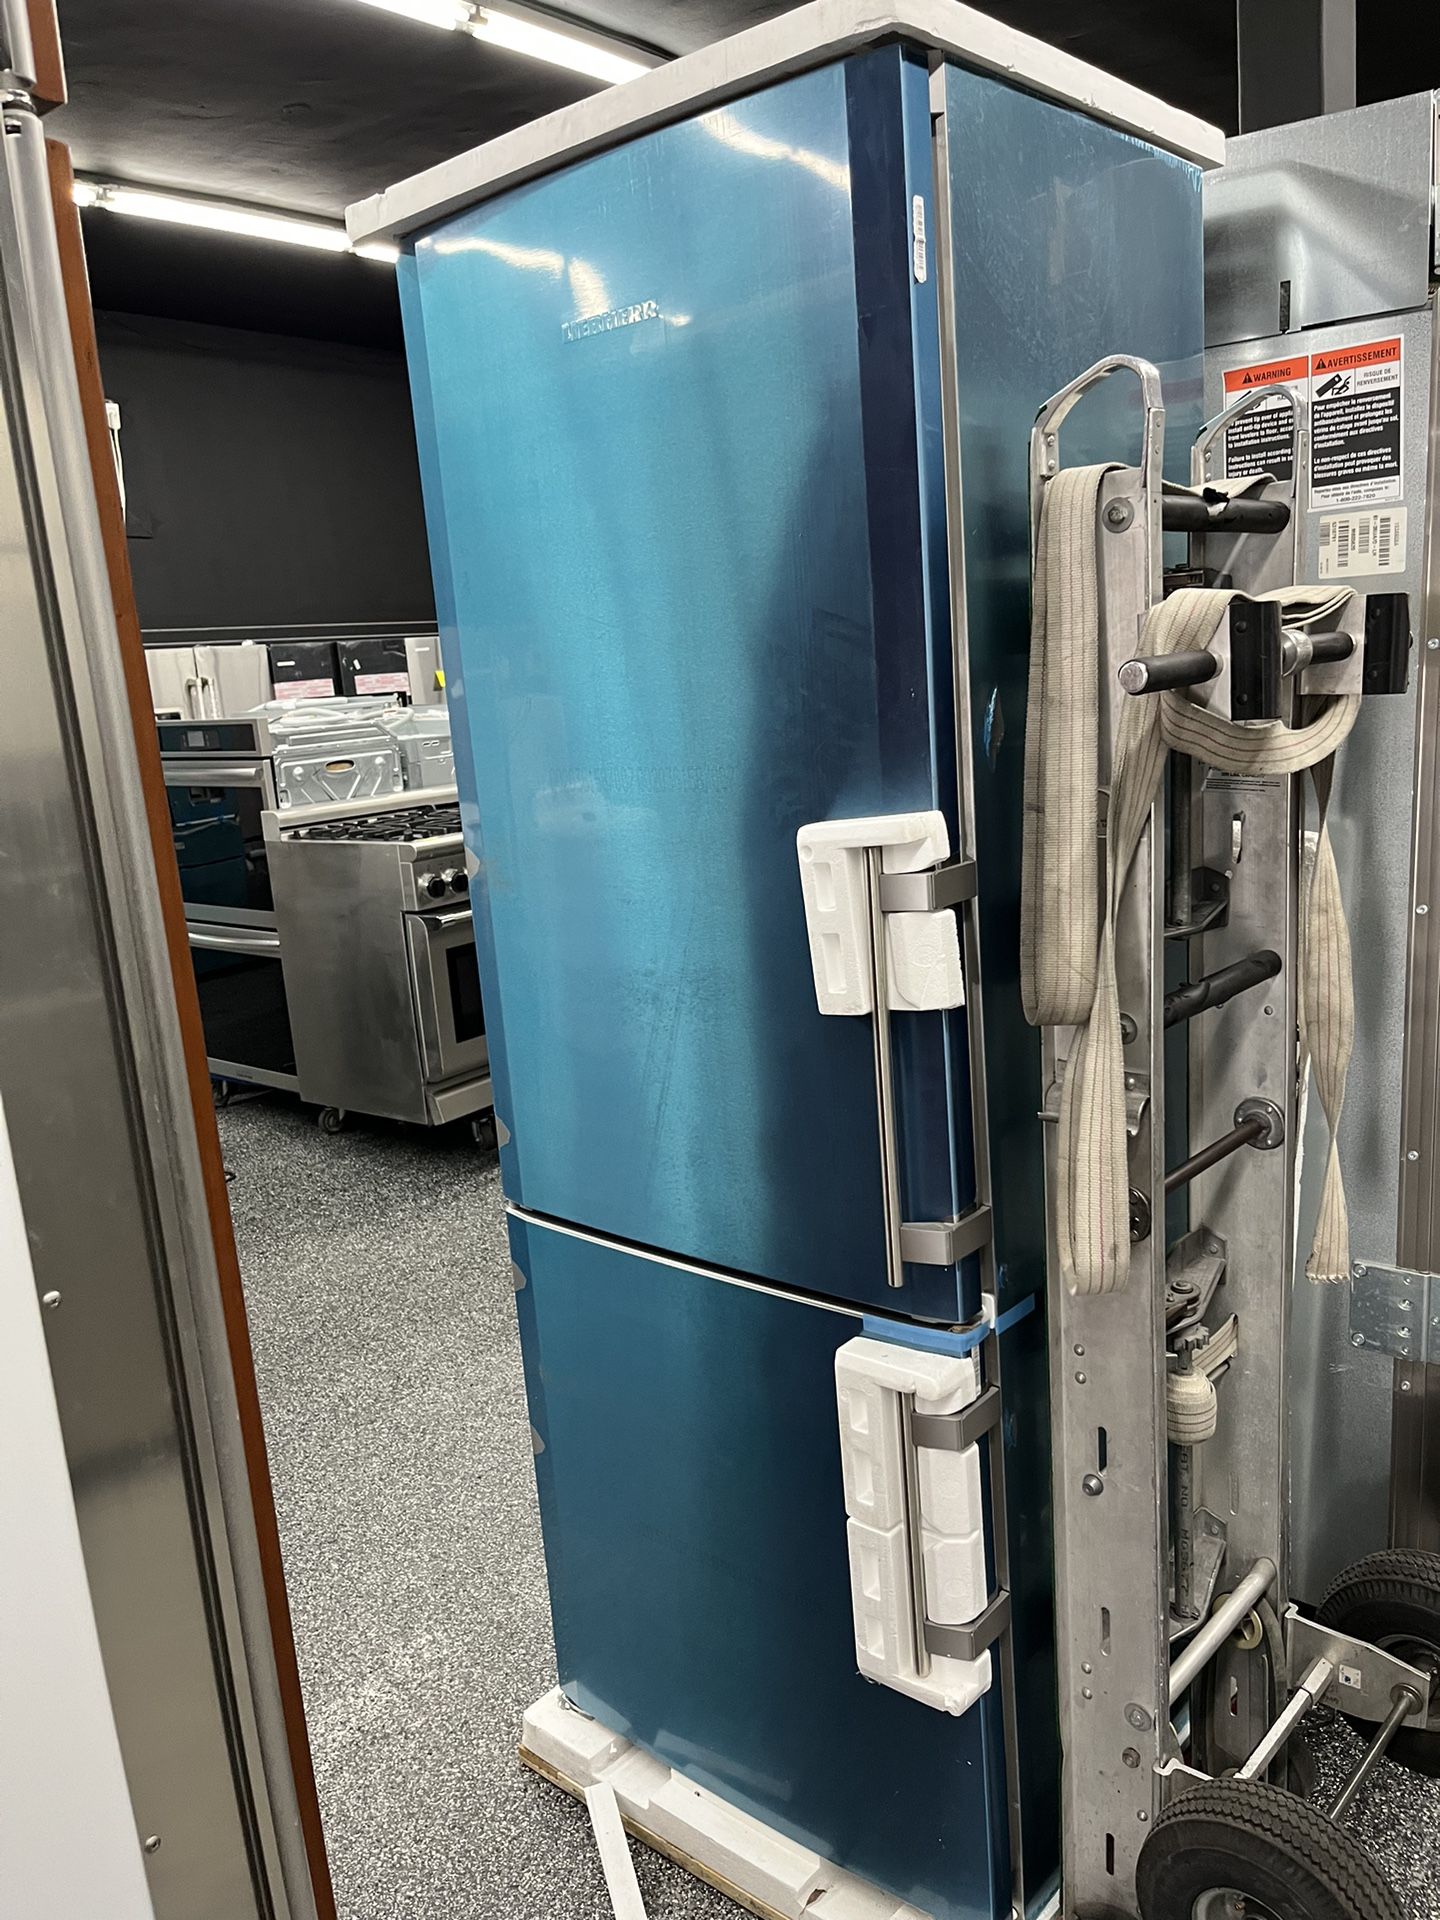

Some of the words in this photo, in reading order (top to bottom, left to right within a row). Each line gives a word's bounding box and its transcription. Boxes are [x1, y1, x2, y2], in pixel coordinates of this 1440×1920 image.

[1327, 347, 1397, 368] AVERTISSEMENT
[1253, 367, 1291, 381] WARNING
[1357, 374, 1398, 386] RENVERSEMENT
[1267, 448, 1291, 457] according
[1367, 447, 1391, 456] directives
[1338, 469, 1354, 477] graves
